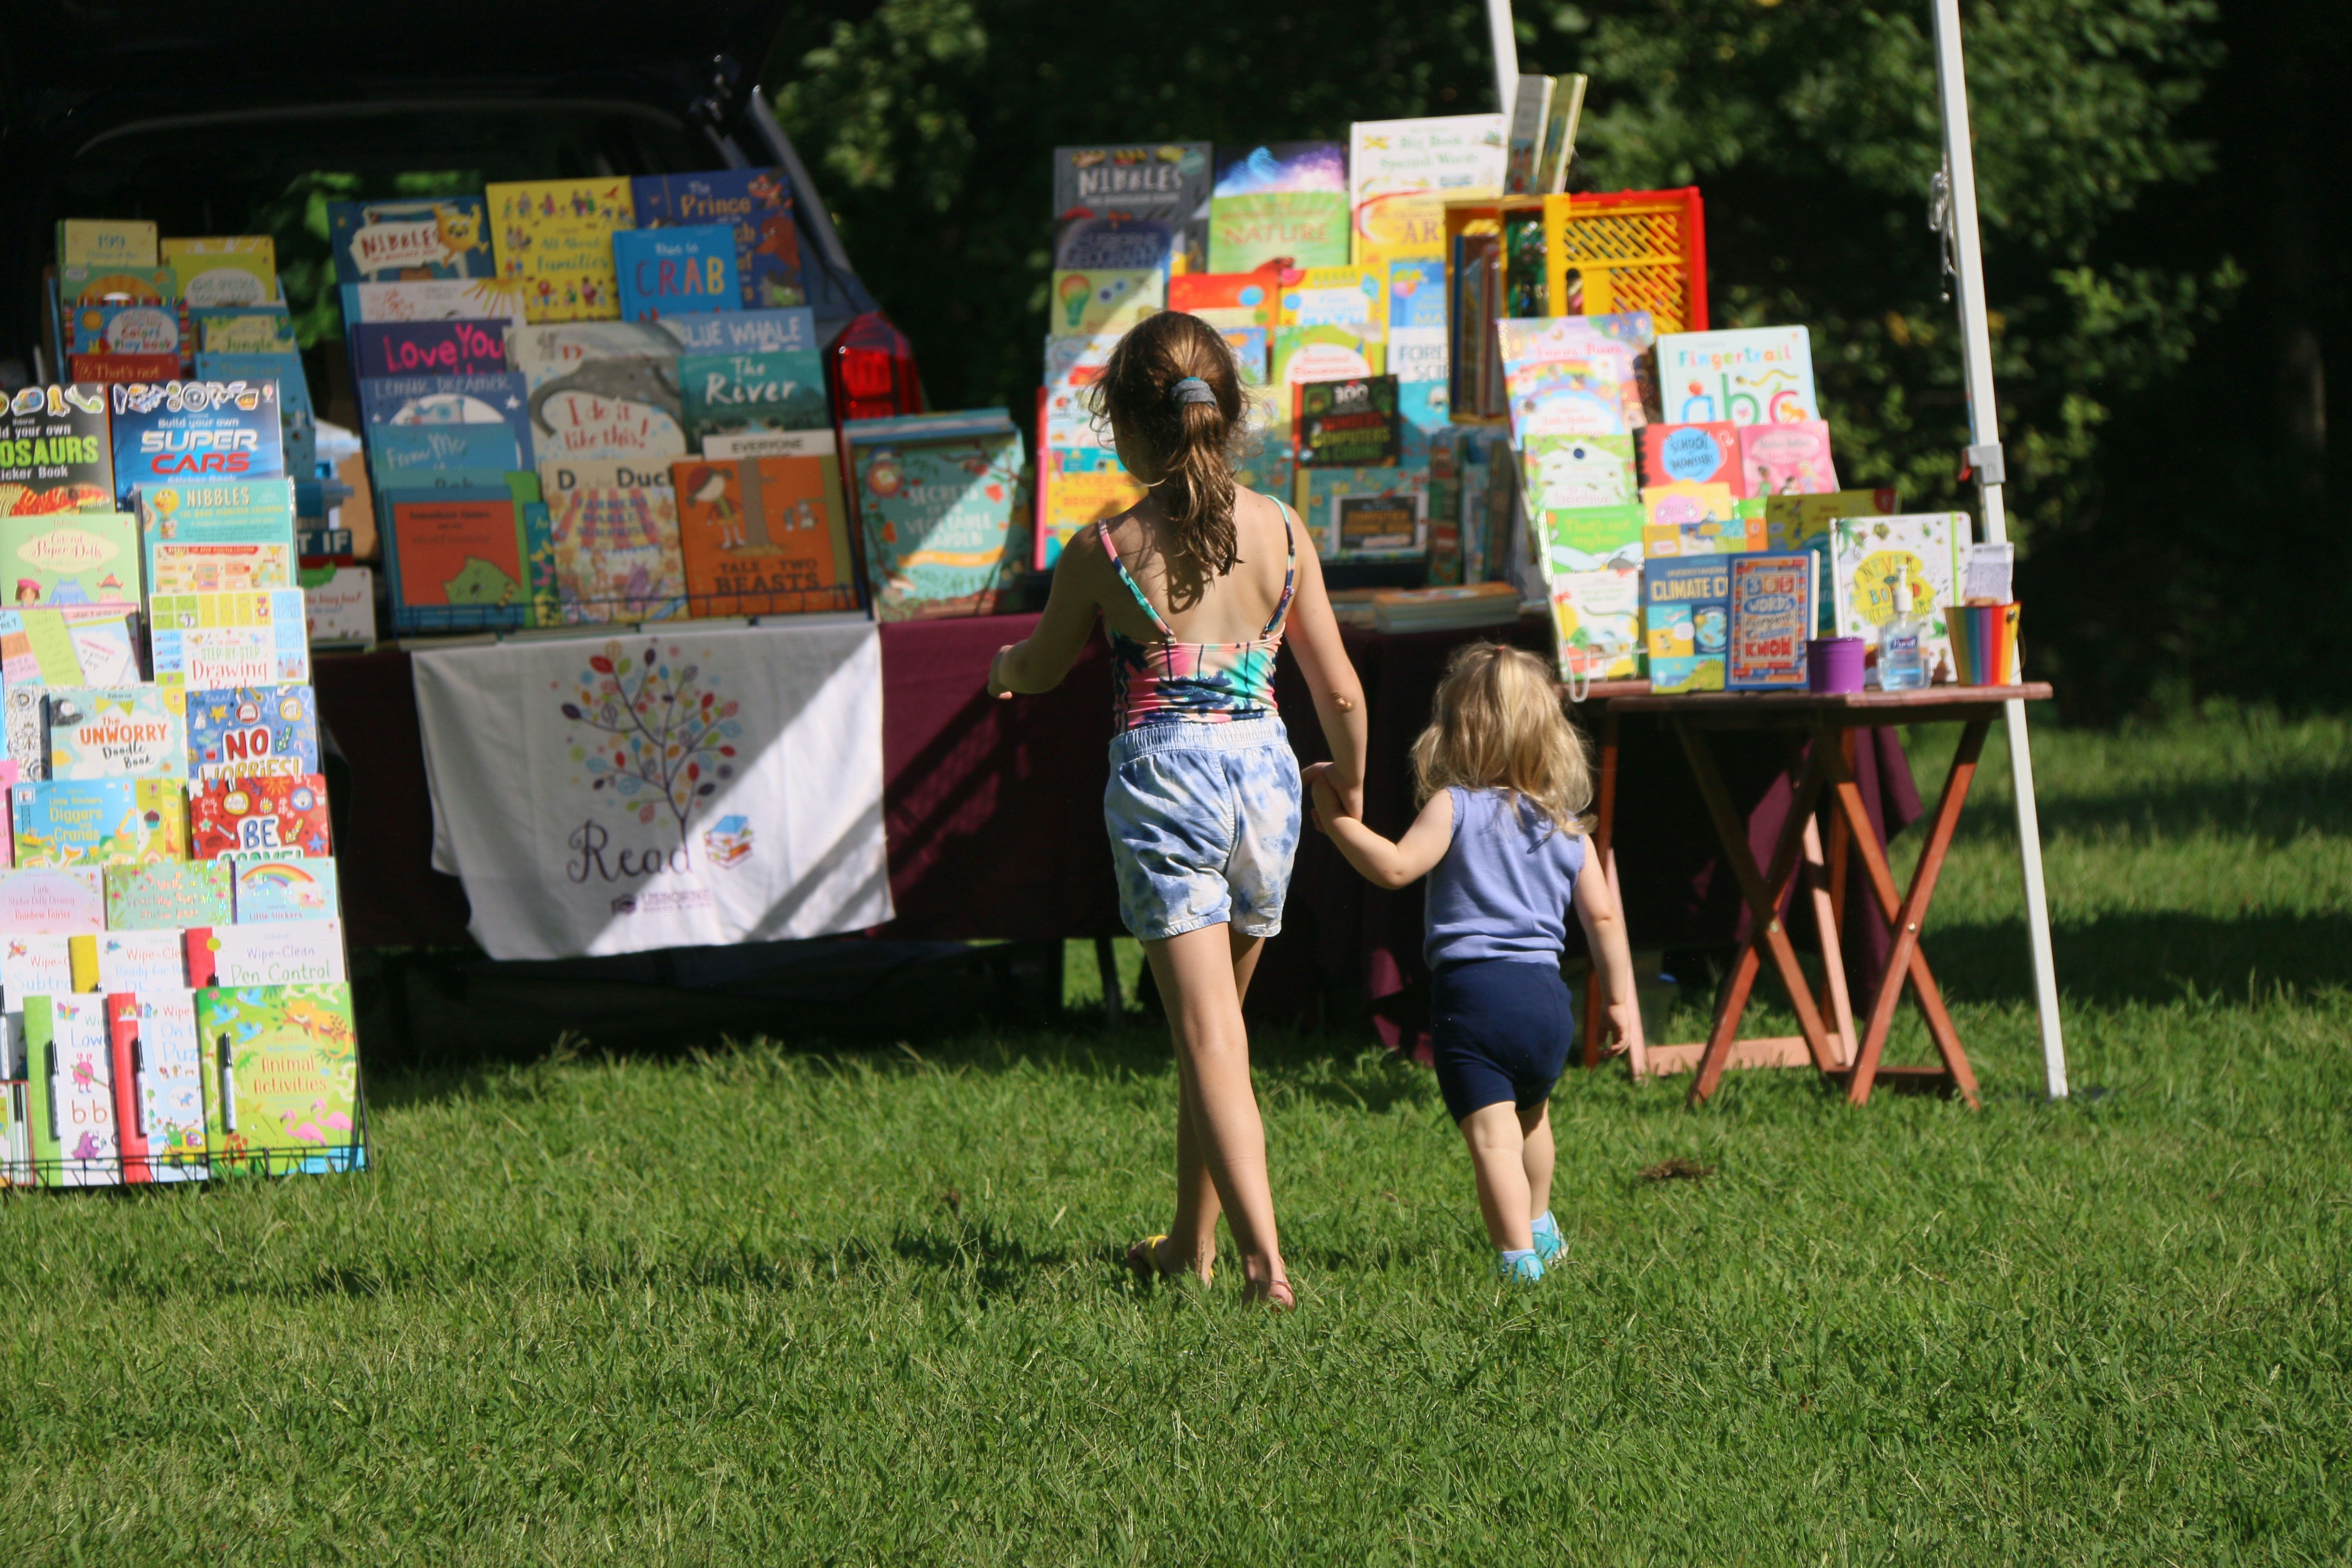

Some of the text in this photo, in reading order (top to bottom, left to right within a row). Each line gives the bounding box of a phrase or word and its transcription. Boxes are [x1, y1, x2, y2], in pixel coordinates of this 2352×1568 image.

[688, 181, 710, 195] The
[1079, 166, 1182, 199] NIBBLES
[681, 195, 751, 218] Prince
[1224, 223, 1331, 247] NATURE
[537, 253, 609, 272] Families
[636, 256, 725, 297] CRAB
[728, 316, 802, 346] WHALE
[383, 323, 503, 374] Love You
[1679, 344, 1793, 371] Fingertrail
[137, 365, 160, 379] not
[729, 355, 766, 377] The
[705, 372, 797, 406] River
[1334, 384, 1369, 404] 100
[567, 397, 582, 426] I
[15, 425, 41, 441] your
[46, 424, 71, 436] own
[158, 417, 240, 429] Build your own
[140, 429, 259, 453] SUPER
[565, 417, 649, 451] like this!
[1669, 436, 1708, 452] SCHOOL
[0, 435, 99, 469] OSAURS
[732, 439, 802, 454] EVERYONE
[151, 452, 250, 474] CARS
[1670, 454, 1714, 470] MONSTERS
[0, 465, 68, 481] icker Book
[558, 469, 576, 490] D
[186, 486, 251, 508] NIBBLES
[28, 538, 102, 559] Paper Dolls
[780, 559, 817, 571] TWO
[715, 572, 820, 595] BEASTS
[1651, 577, 1712, 601] CLIMATE
[1748, 576, 1792, 594] 365
[1749, 595, 1792, 612] WORDS
[201, 645, 260, 662] STEP-BY-STEP
[1745, 637, 1792, 657] KNOW
[192, 659, 267, 684] Drawing
[102, 716, 120, 726] The
[80, 723, 168, 746] UNWORRY
[225, 728, 269, 761] NO
[102, 739, 147, 760] Doodle
[123, 754, 154, 769] Book
[49, 796, 102, 806] Little Stickers
[49, 808, 103, 824] Diggers
[54, 827, 100, 842] Cranes
[244, 818, 278, 850] BE
[566, 819, 692, 884] Read
[33, 884, 49, 894] Little
[15, 908, 71, 921] Rainbow Fairies
[249, 911, 303, 921] Little Stickers
[30, 956, 69, 972] Wipe-C
[126, 946, 182, 966] Wipe-Cle
[246, 944, 315, 965] Wipe-Clean
[231, 958, 330, 986] Pen Control
[262, 1054, 316, 1073] Animal
[254, 1076, 328, 1095] Activities
